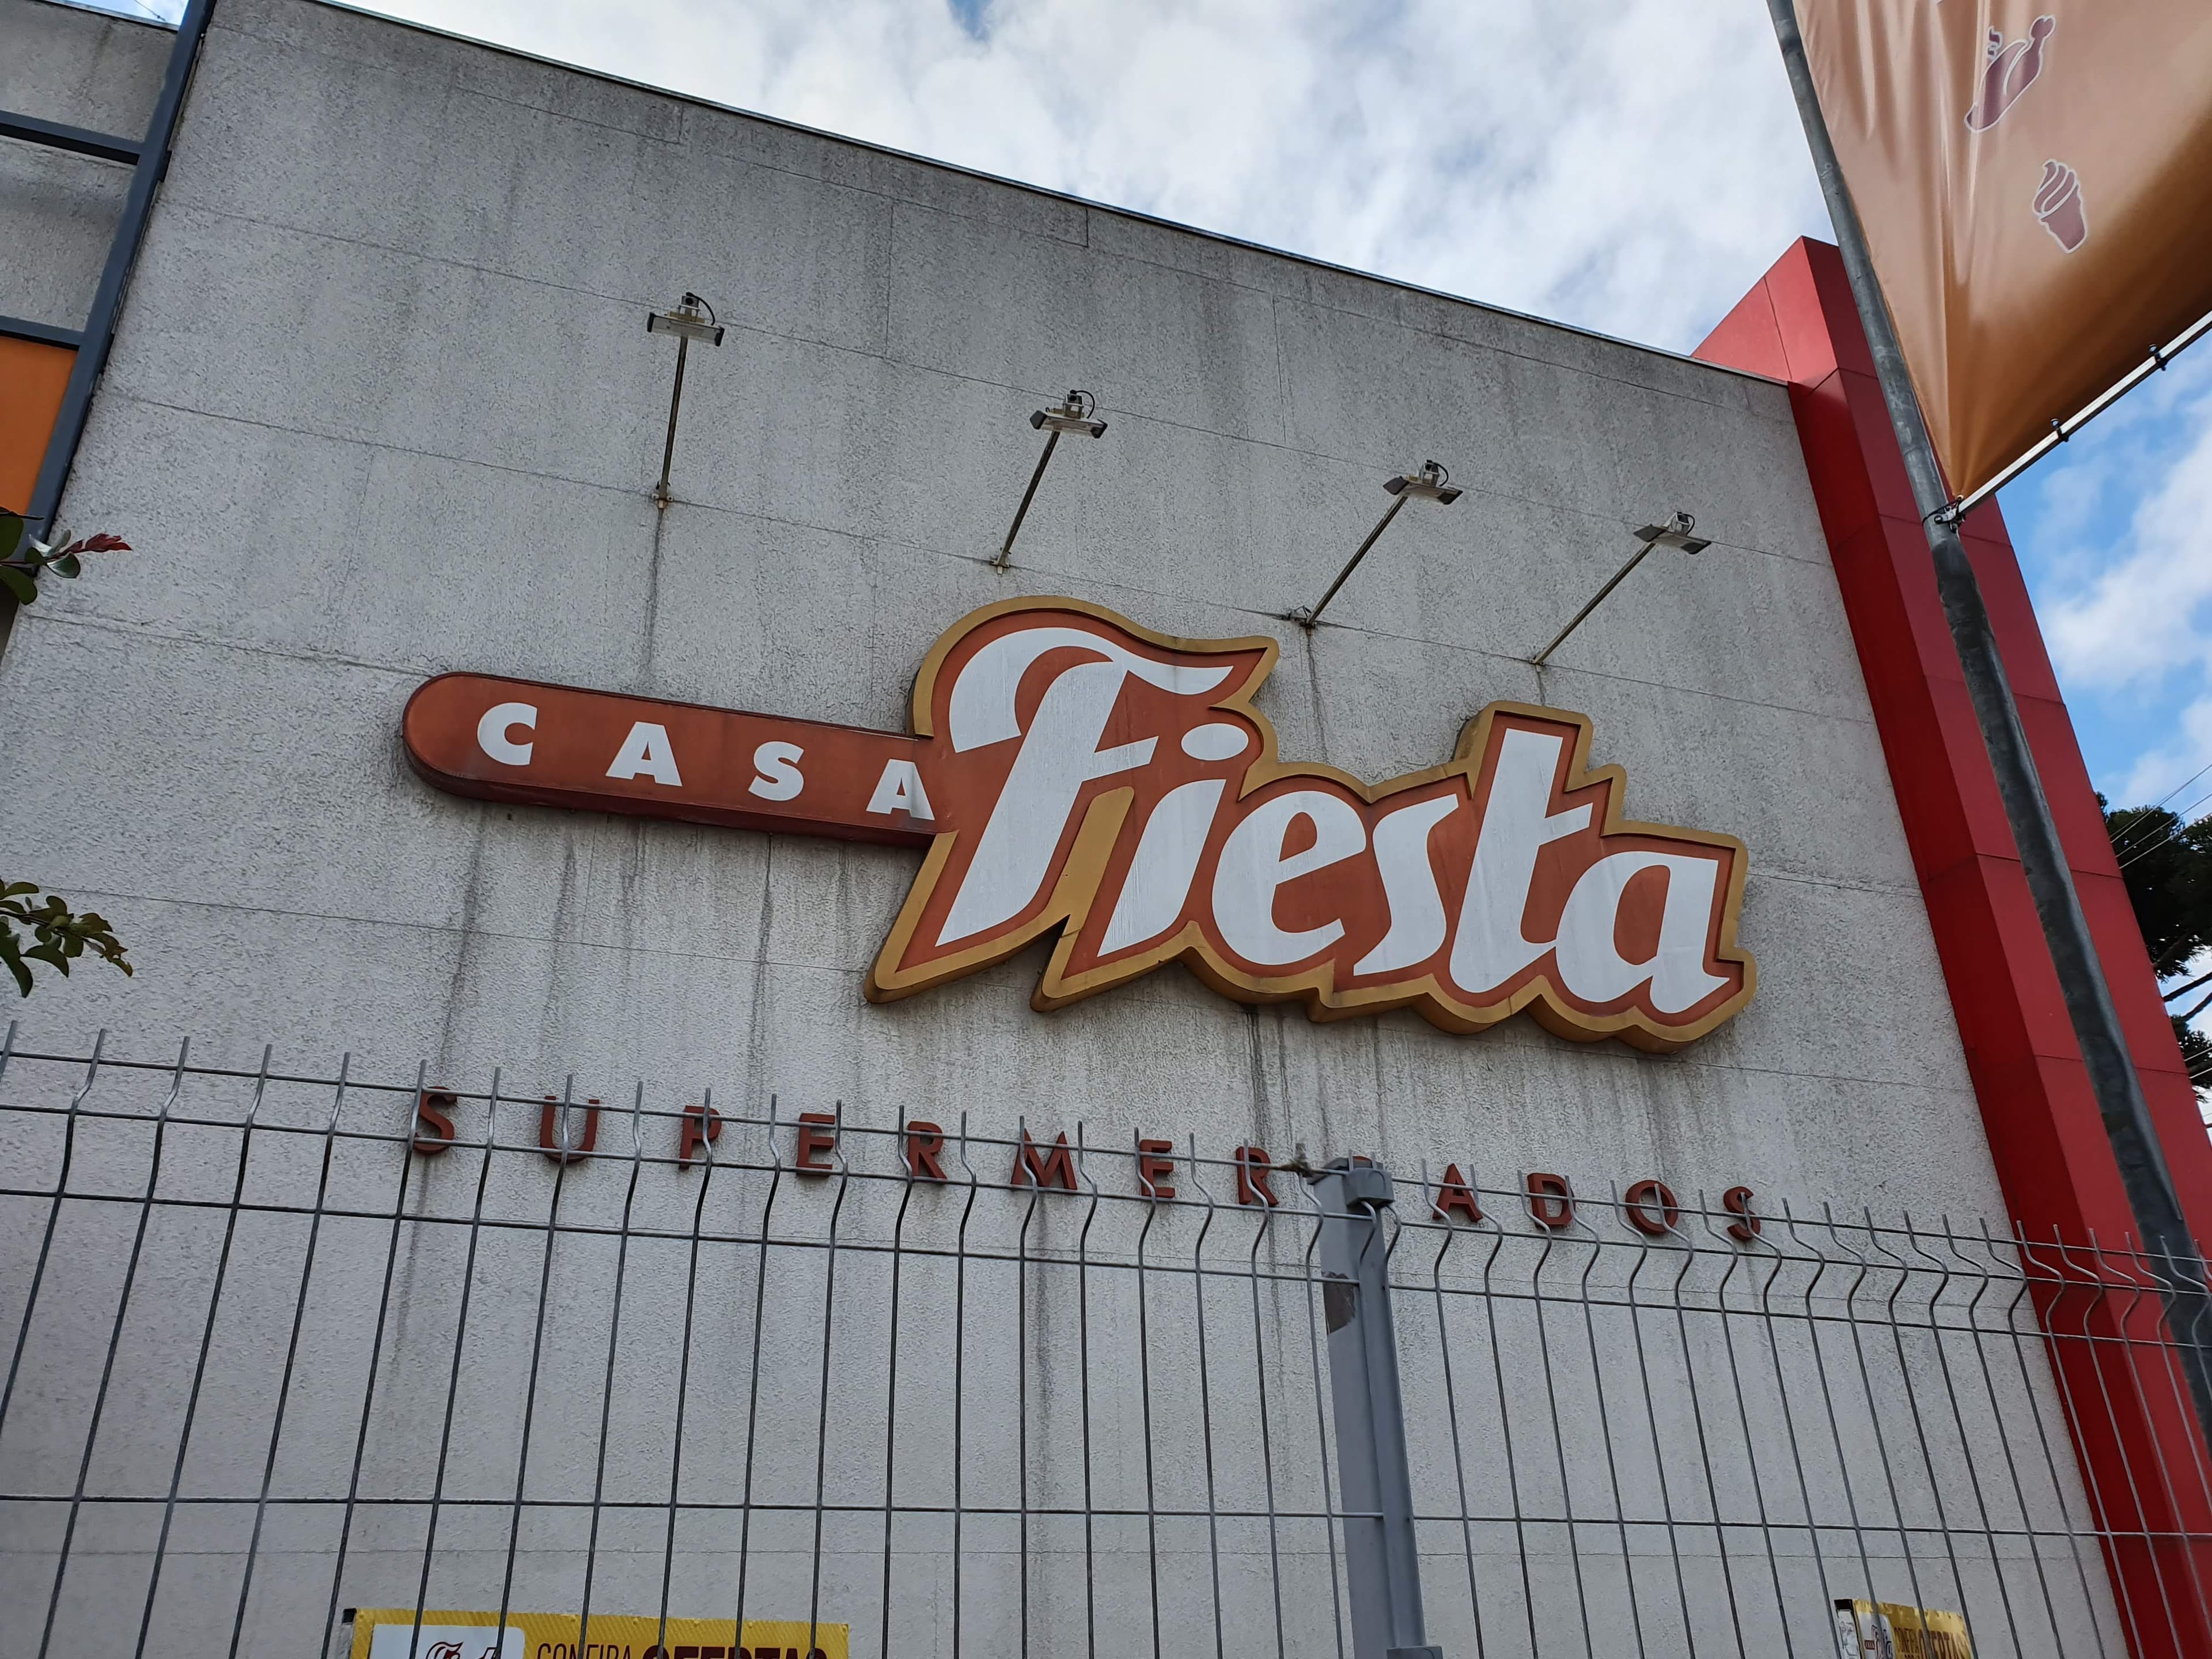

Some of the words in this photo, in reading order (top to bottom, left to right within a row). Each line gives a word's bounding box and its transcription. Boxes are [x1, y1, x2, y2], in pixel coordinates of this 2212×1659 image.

[476, 702, 935, 821] CASA
[935, 627, 1730, 1013] Fiesta
[411, 1086, 1762, 1241] SUPERMERADOS
